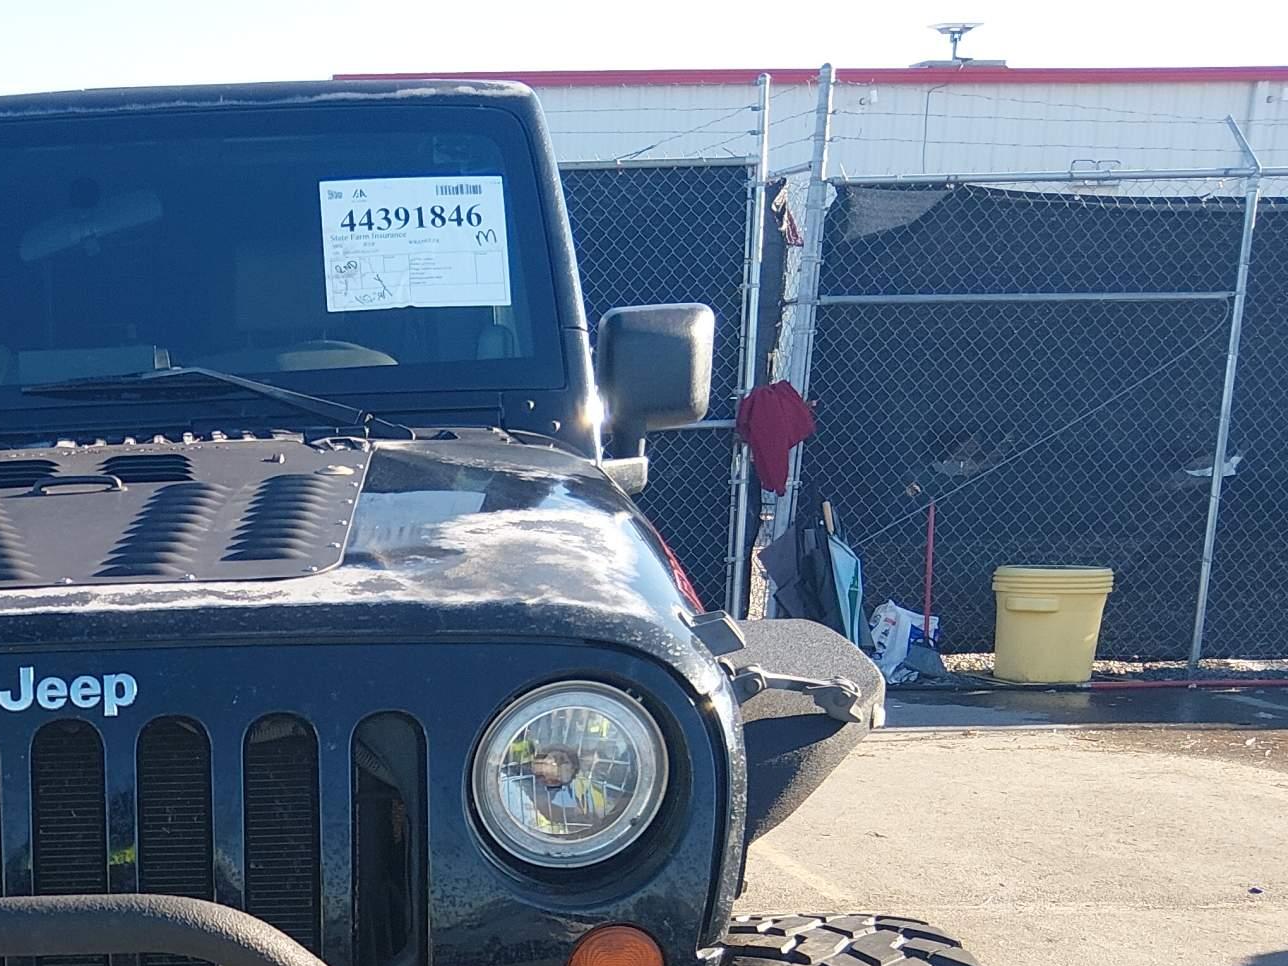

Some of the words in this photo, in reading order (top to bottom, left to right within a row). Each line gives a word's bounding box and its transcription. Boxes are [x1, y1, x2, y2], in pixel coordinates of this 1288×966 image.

[340, 203, 483, 233] 44391846
[330, 233, 348, 242] State
[350, 232, 370, 241] Farm
[371, 231, 407, 240] Insurance
